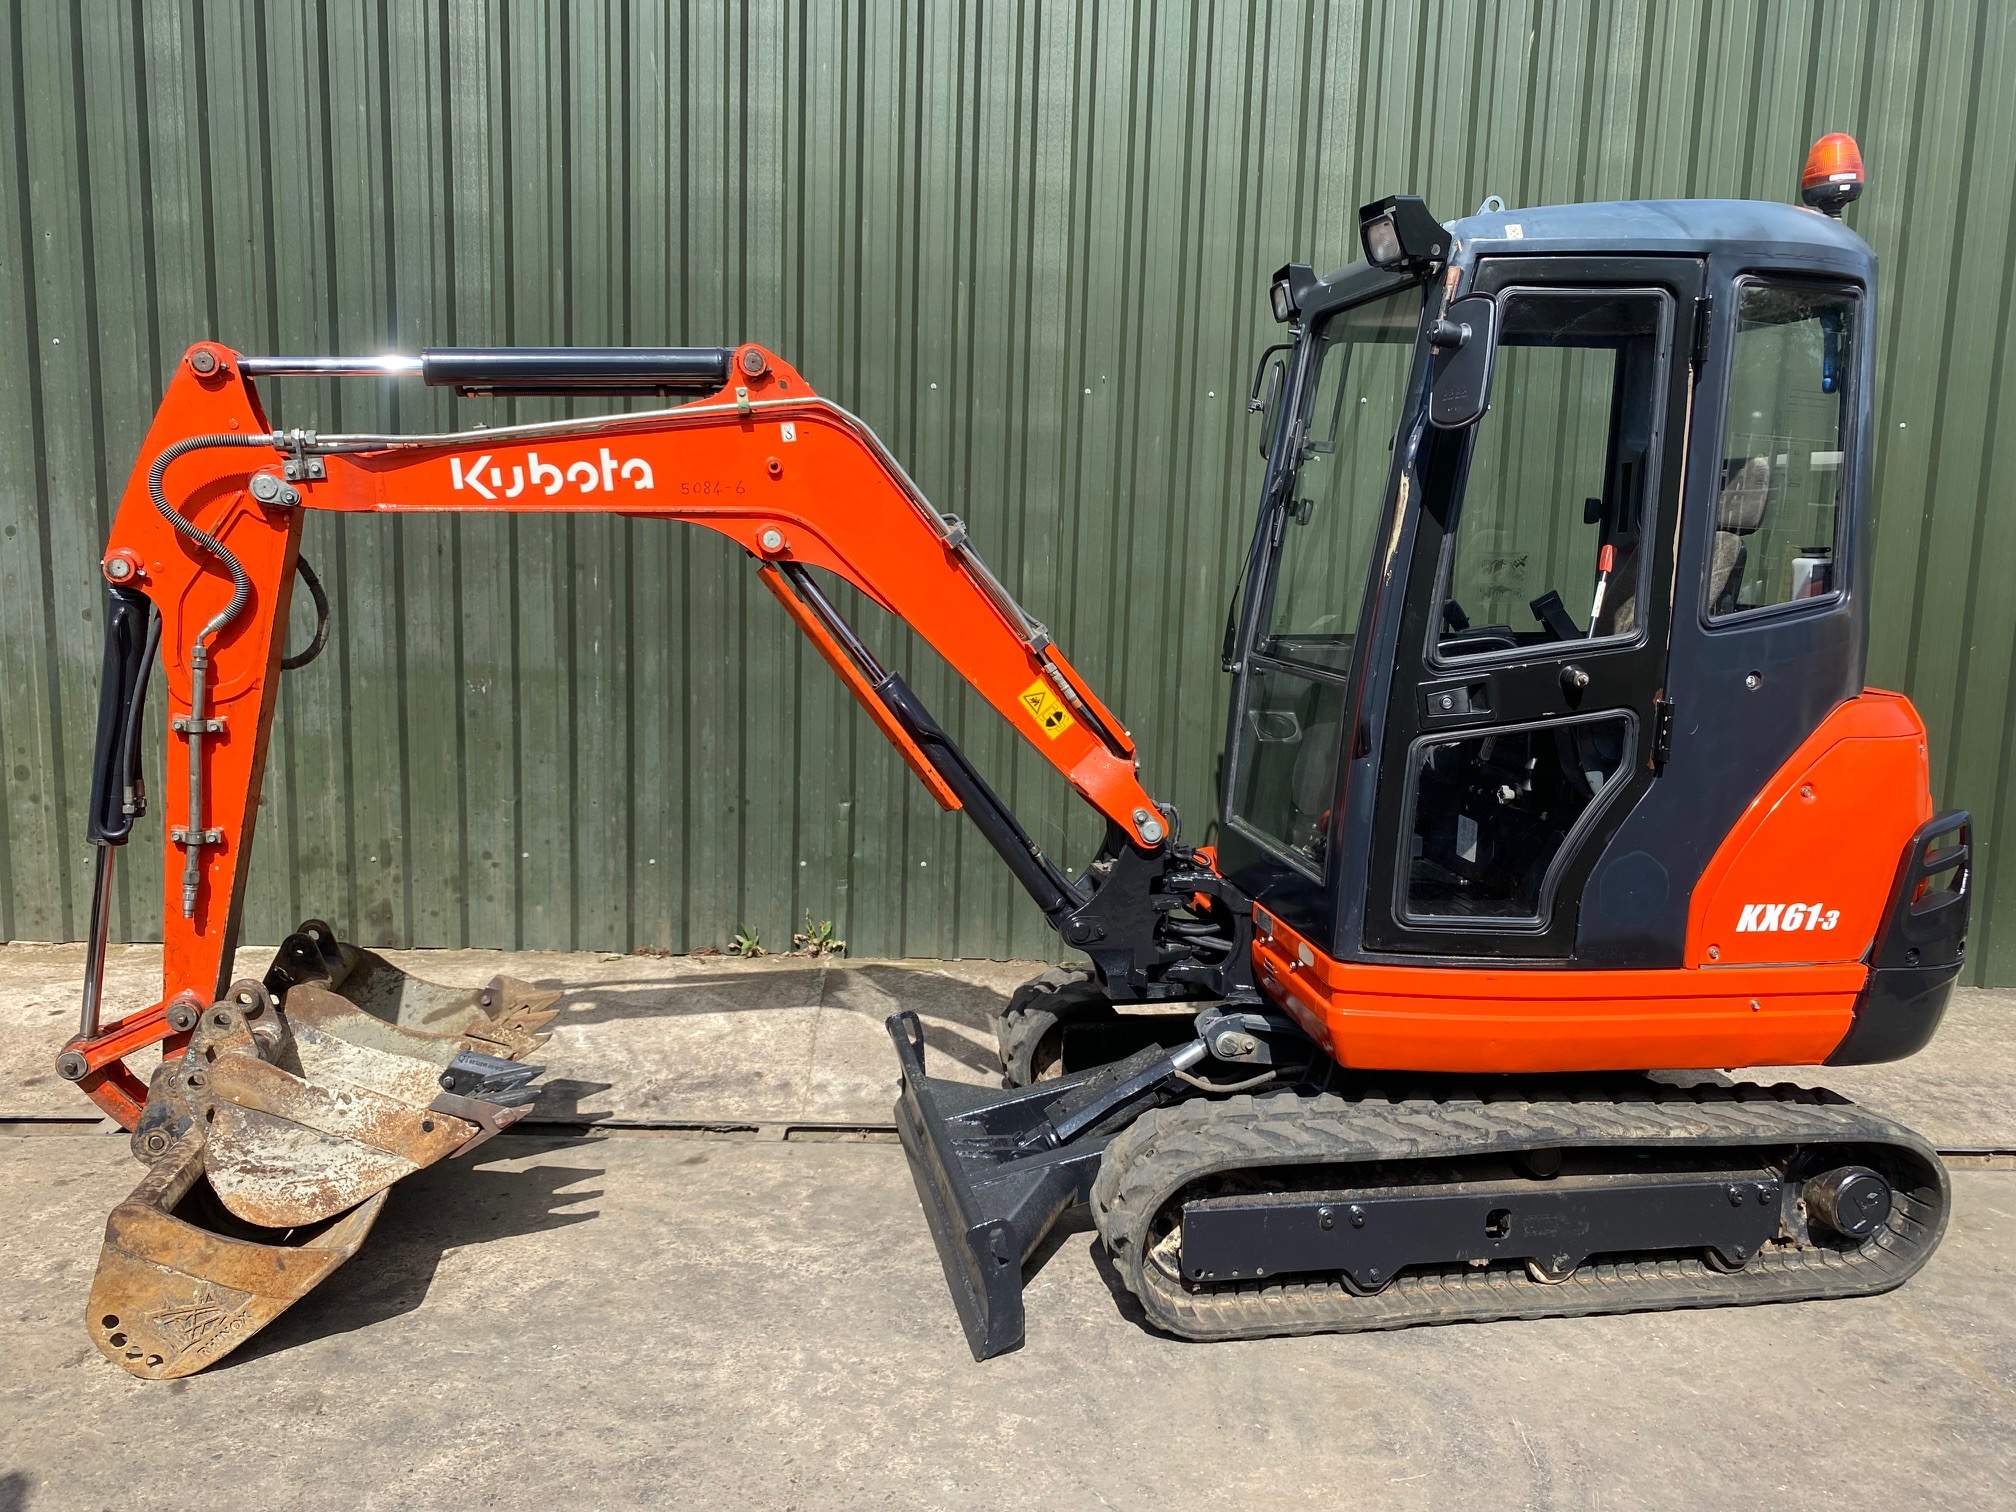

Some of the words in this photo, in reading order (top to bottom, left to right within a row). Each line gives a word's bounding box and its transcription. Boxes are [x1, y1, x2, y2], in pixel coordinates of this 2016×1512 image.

[450, 448, 654, 499] Kubota
[680, 480, 745, 495] 5084-6
[1736, 902, 1840, 932] KX61-3
